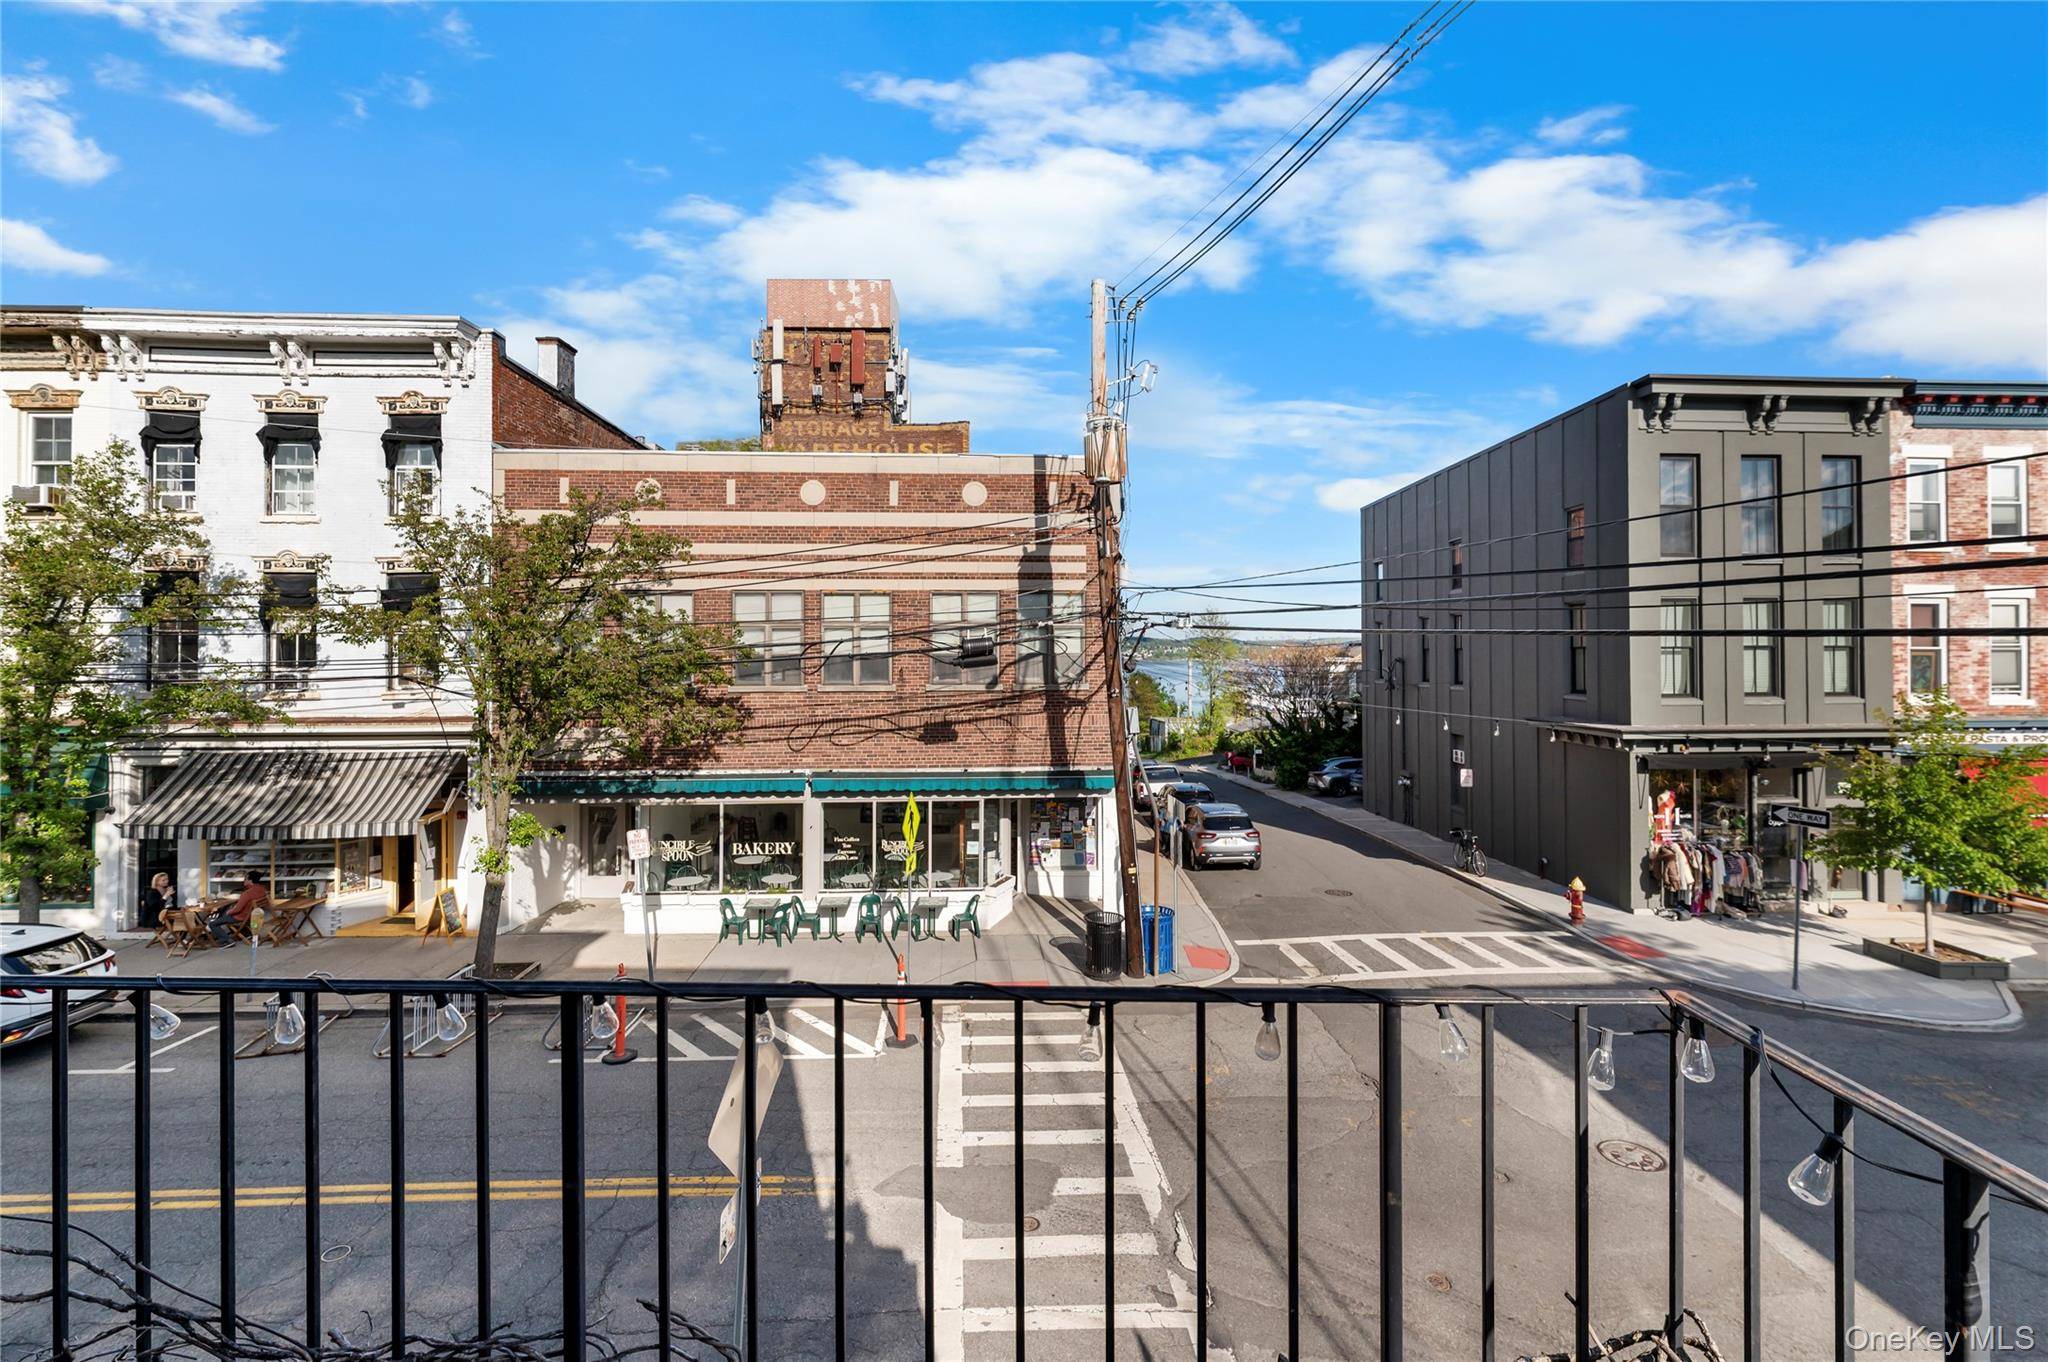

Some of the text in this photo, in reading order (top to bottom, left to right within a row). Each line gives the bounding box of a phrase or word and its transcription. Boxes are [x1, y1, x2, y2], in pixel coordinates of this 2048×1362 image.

[781, 421, 880, 437] STORAGE
[1970, 734, 2007, 743] PASTA
[2023, 734, 2048, 743] PRO
[1787, 811, 1823, 823] ONE WAY
[732, 842, 795, 855] BAKERY
[661, 849, 694, 862] SPOON
